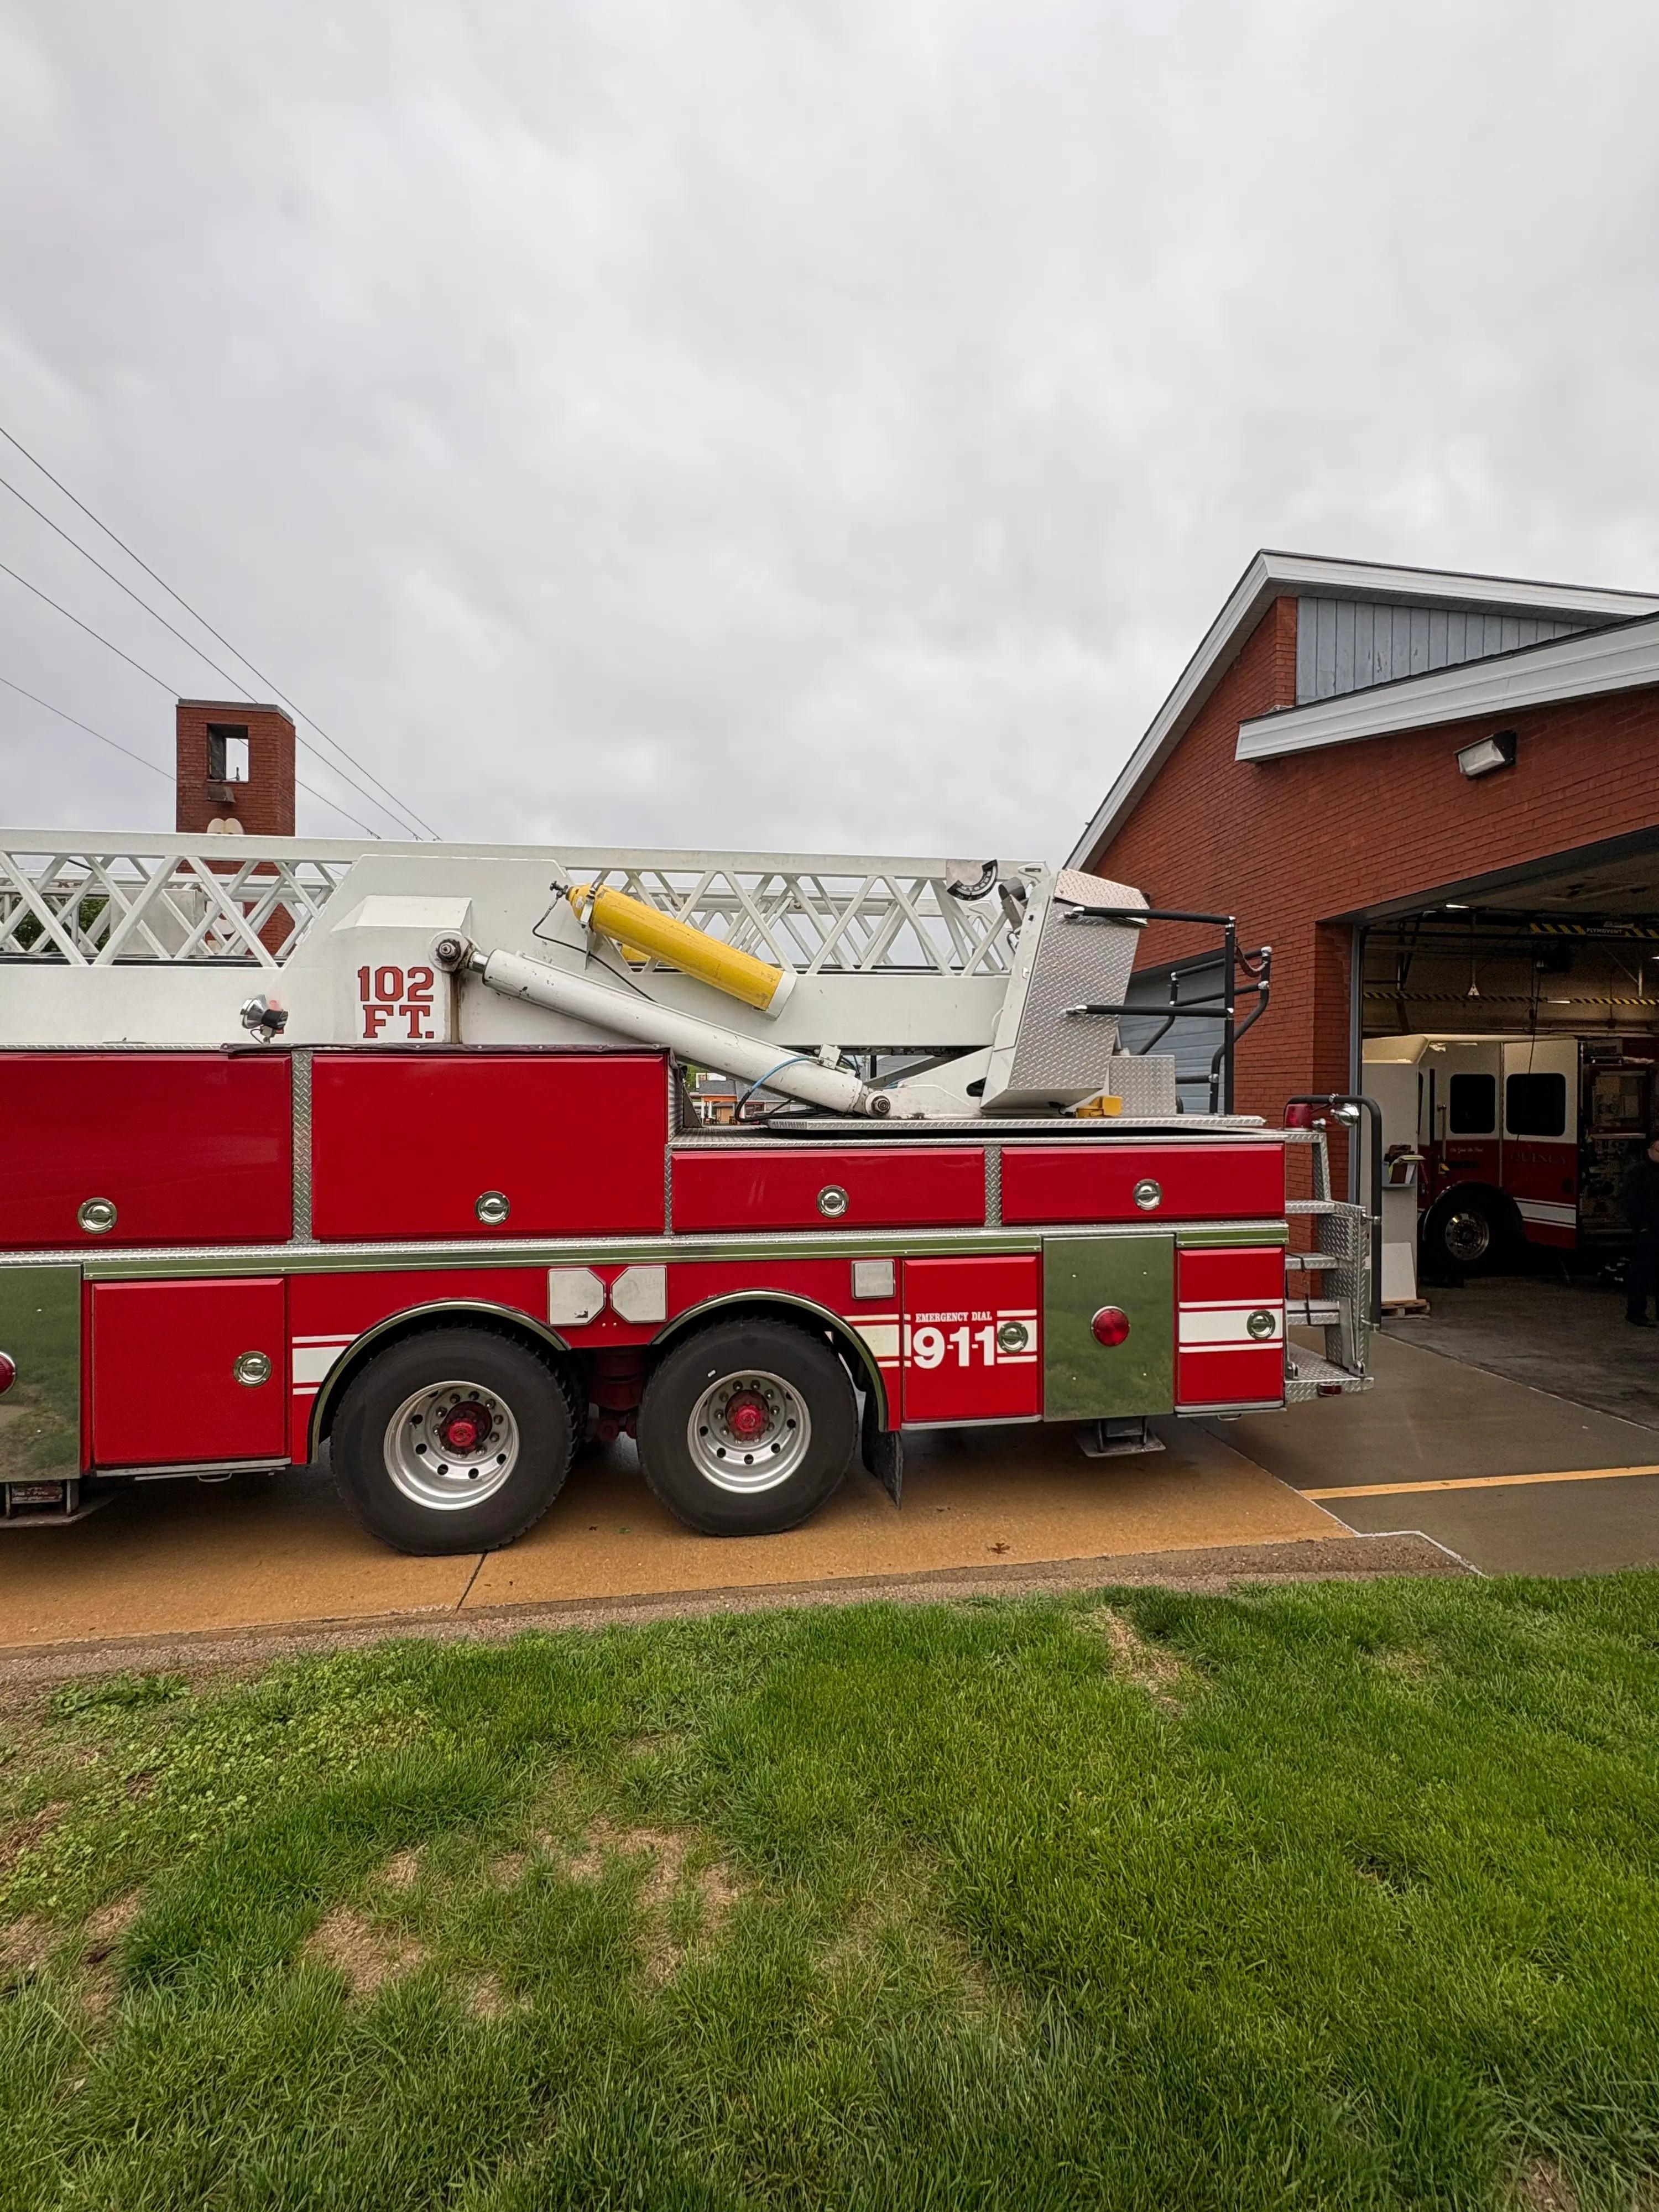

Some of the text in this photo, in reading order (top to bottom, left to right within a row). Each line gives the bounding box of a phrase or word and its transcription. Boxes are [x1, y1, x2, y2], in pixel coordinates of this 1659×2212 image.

[358, 966, 434, 1001] 102
[363, 1004, 434, 1039] FT.
[915, 1311, 993, 1323] EMERGENCY DIAL
[913, 1326, 994, 1369] 9-1-1
